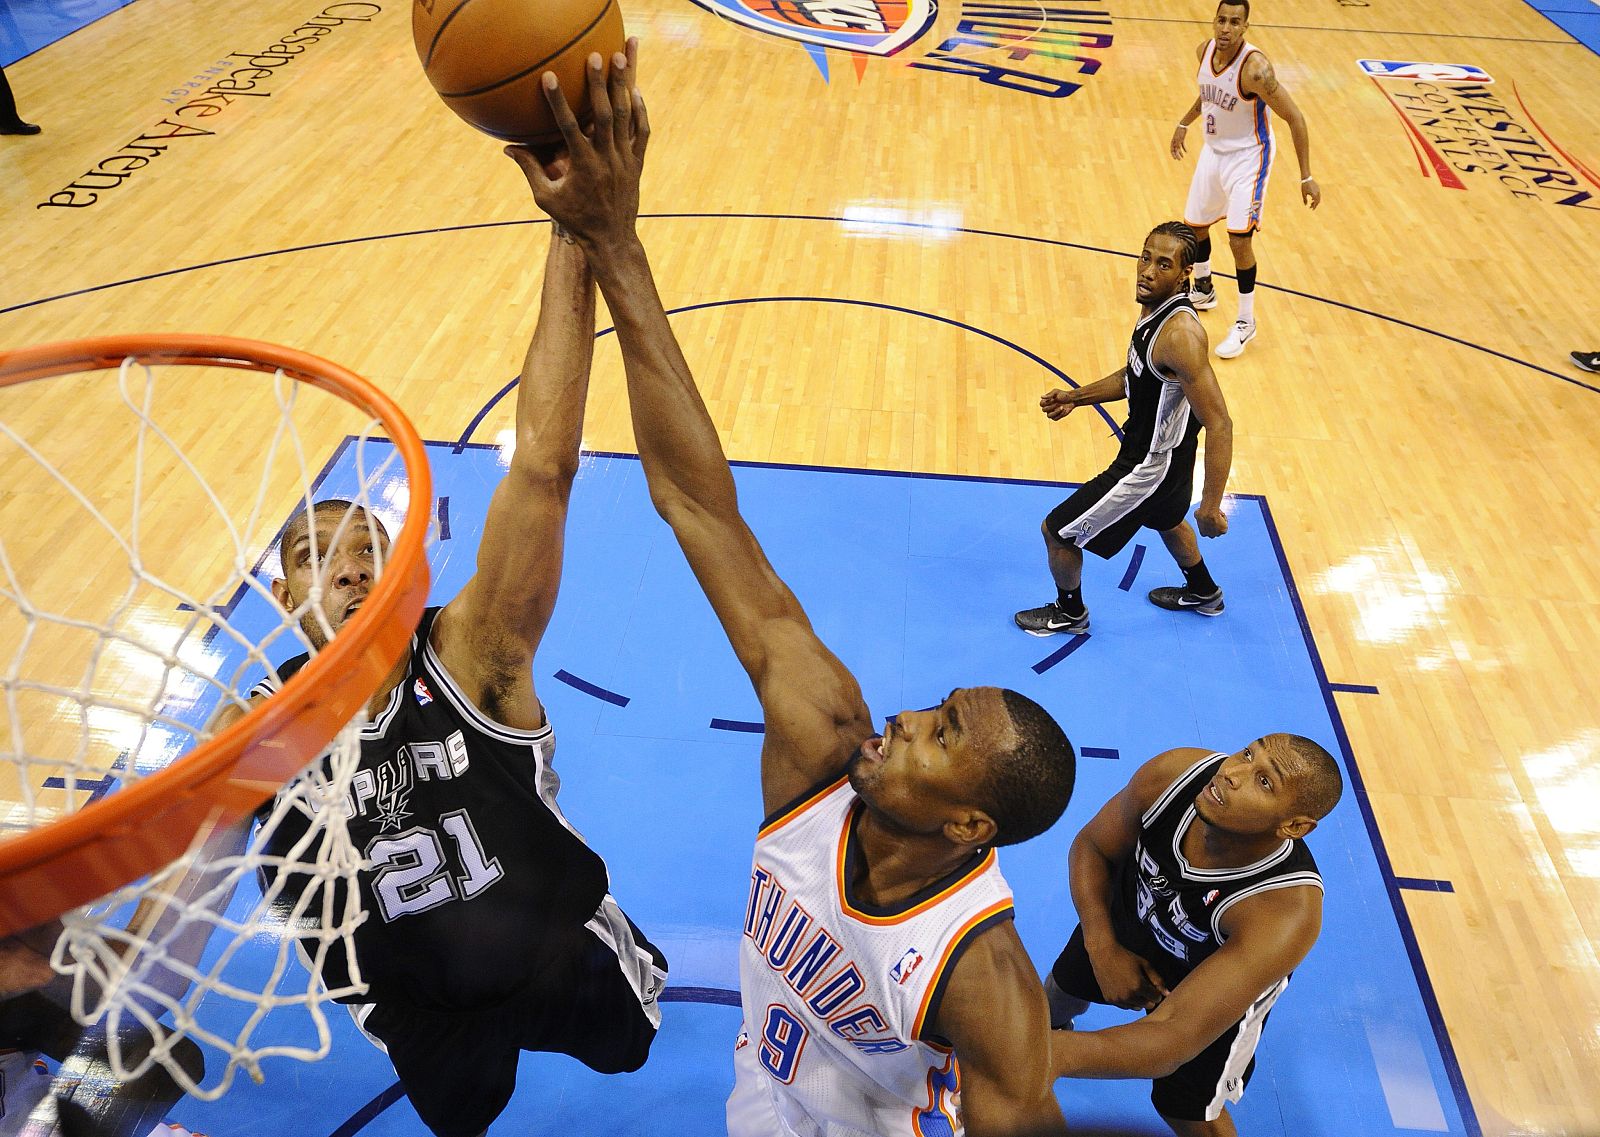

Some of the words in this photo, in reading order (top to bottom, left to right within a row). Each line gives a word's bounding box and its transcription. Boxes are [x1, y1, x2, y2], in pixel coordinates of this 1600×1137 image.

[163, 60, 234, 105] ENERGY
[175, 2, 382, 118] Chesapeake
[905, 0, 1114, 98] NDER
[1199, 83, 1238, 113] HUNDER
[1206, 113, 1217, 135] 2
[1395, 93, 1488, 174] FINALS
[1415, 82, 1543, 202] CONFERENCE
[37, 118, 216, 210] Arena
[1446, 84, 1600, 210] WESTERN
[364, 808, 505, 924] 21
[744, 864, 912, 1056] THUNDER
[757, 1003, 810, 1086] 9
